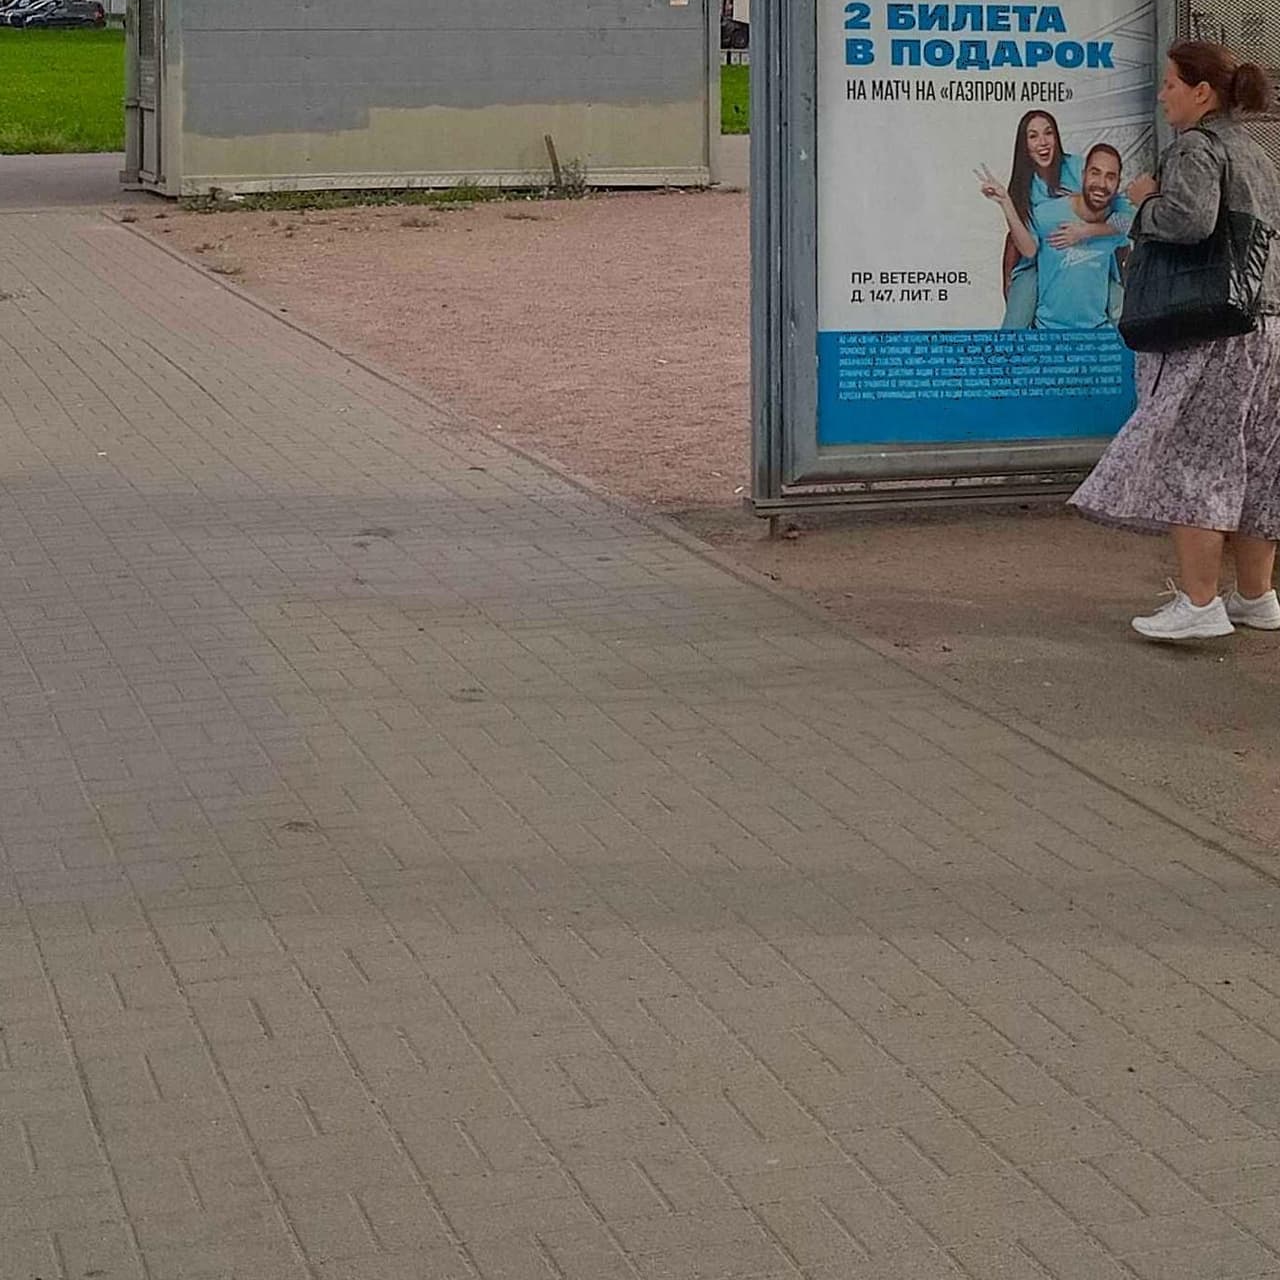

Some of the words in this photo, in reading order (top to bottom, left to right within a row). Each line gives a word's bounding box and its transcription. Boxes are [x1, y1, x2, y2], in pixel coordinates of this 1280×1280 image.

[843, 1, 871, 30] 2
[886, 3, 1067, 33] БИЛЕТА
[845, 38, 875, 66] В
[890, 39, 1115, 70] ПОДАРОК
[846, 80, 867, 102] НА
[871, 80, 911, 102] МАТЧ
[915, 80, 935, 102] НА
[939, 81, 1017, 103] «ГАЗПРОМ
[1020, 82, 1074, 103] АРЕНЕ»
[851, 272, 875, 284] ПР.
[879, 272, 972, 287] ВЕТЕРАНОВ,
[850, 289, 865, 304] Д.
[869, 289, 895, 304] 147,
[898, 289, 933, 302] ЛИТ.
[937, 289, 949, 302] В
